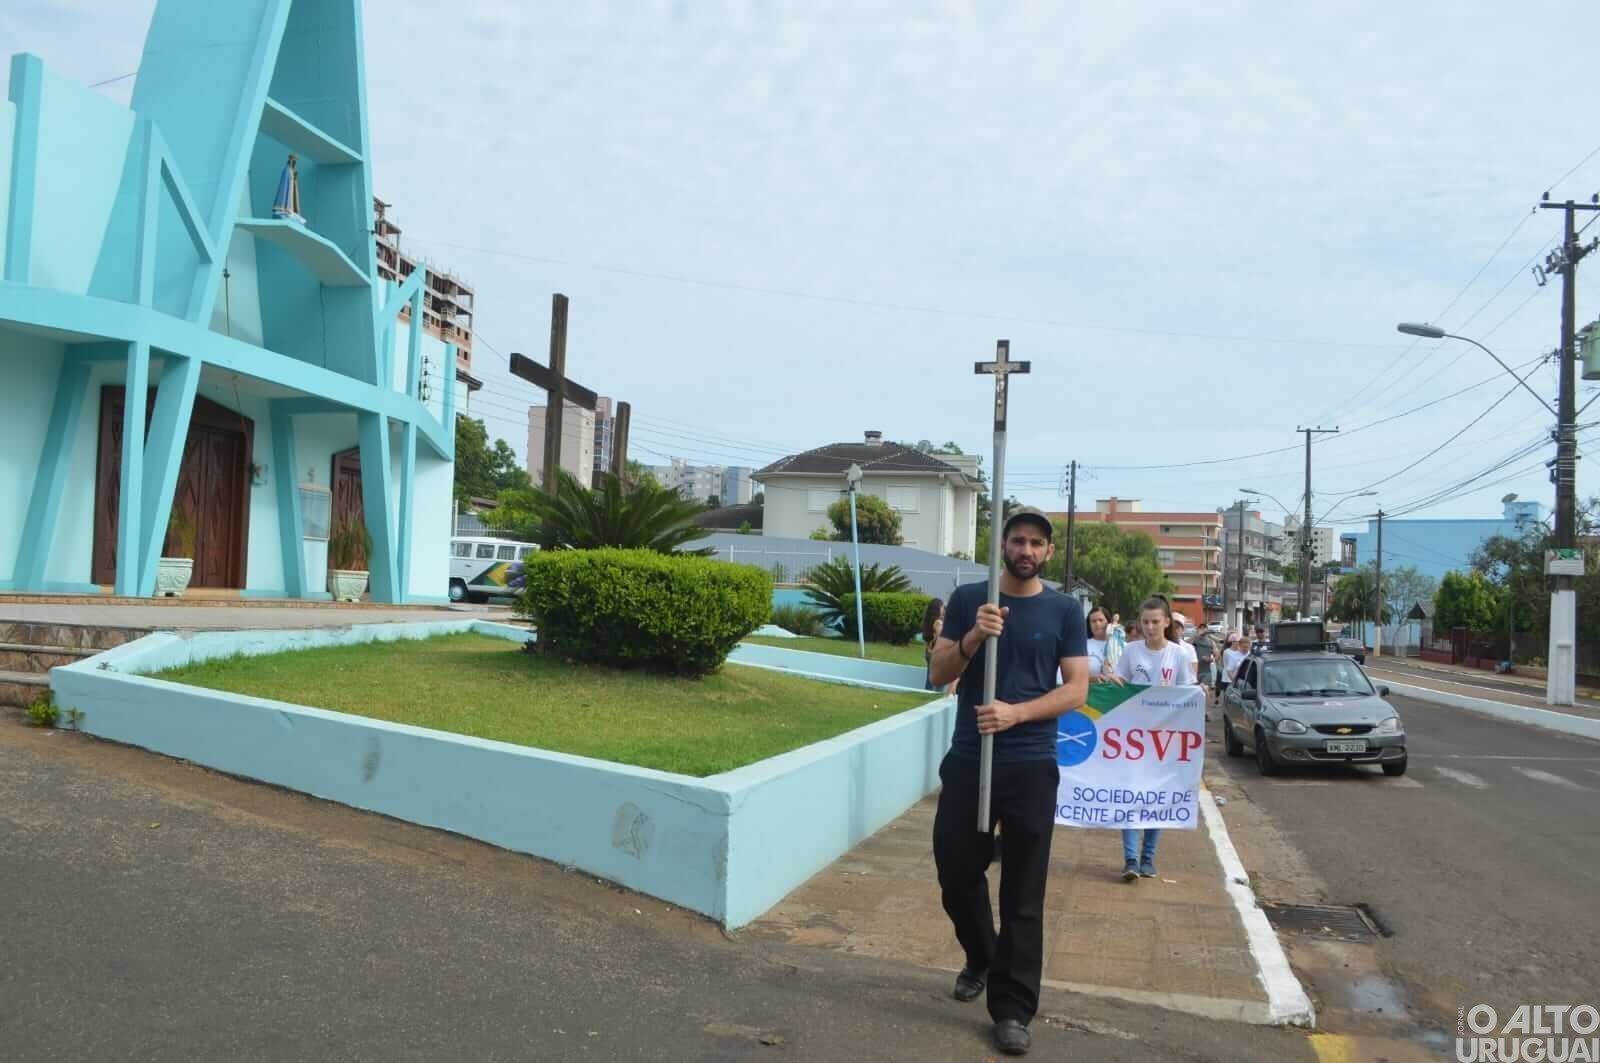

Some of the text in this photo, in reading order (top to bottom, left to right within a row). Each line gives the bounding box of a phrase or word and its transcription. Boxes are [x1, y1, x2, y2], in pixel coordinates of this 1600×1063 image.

[1102, 728, 1202, 762] SSVP
[1073, 787, 1192, 805] SOCIEDADE DE
[1055, 805, 1190, 823] ICENTE DE PAULO
